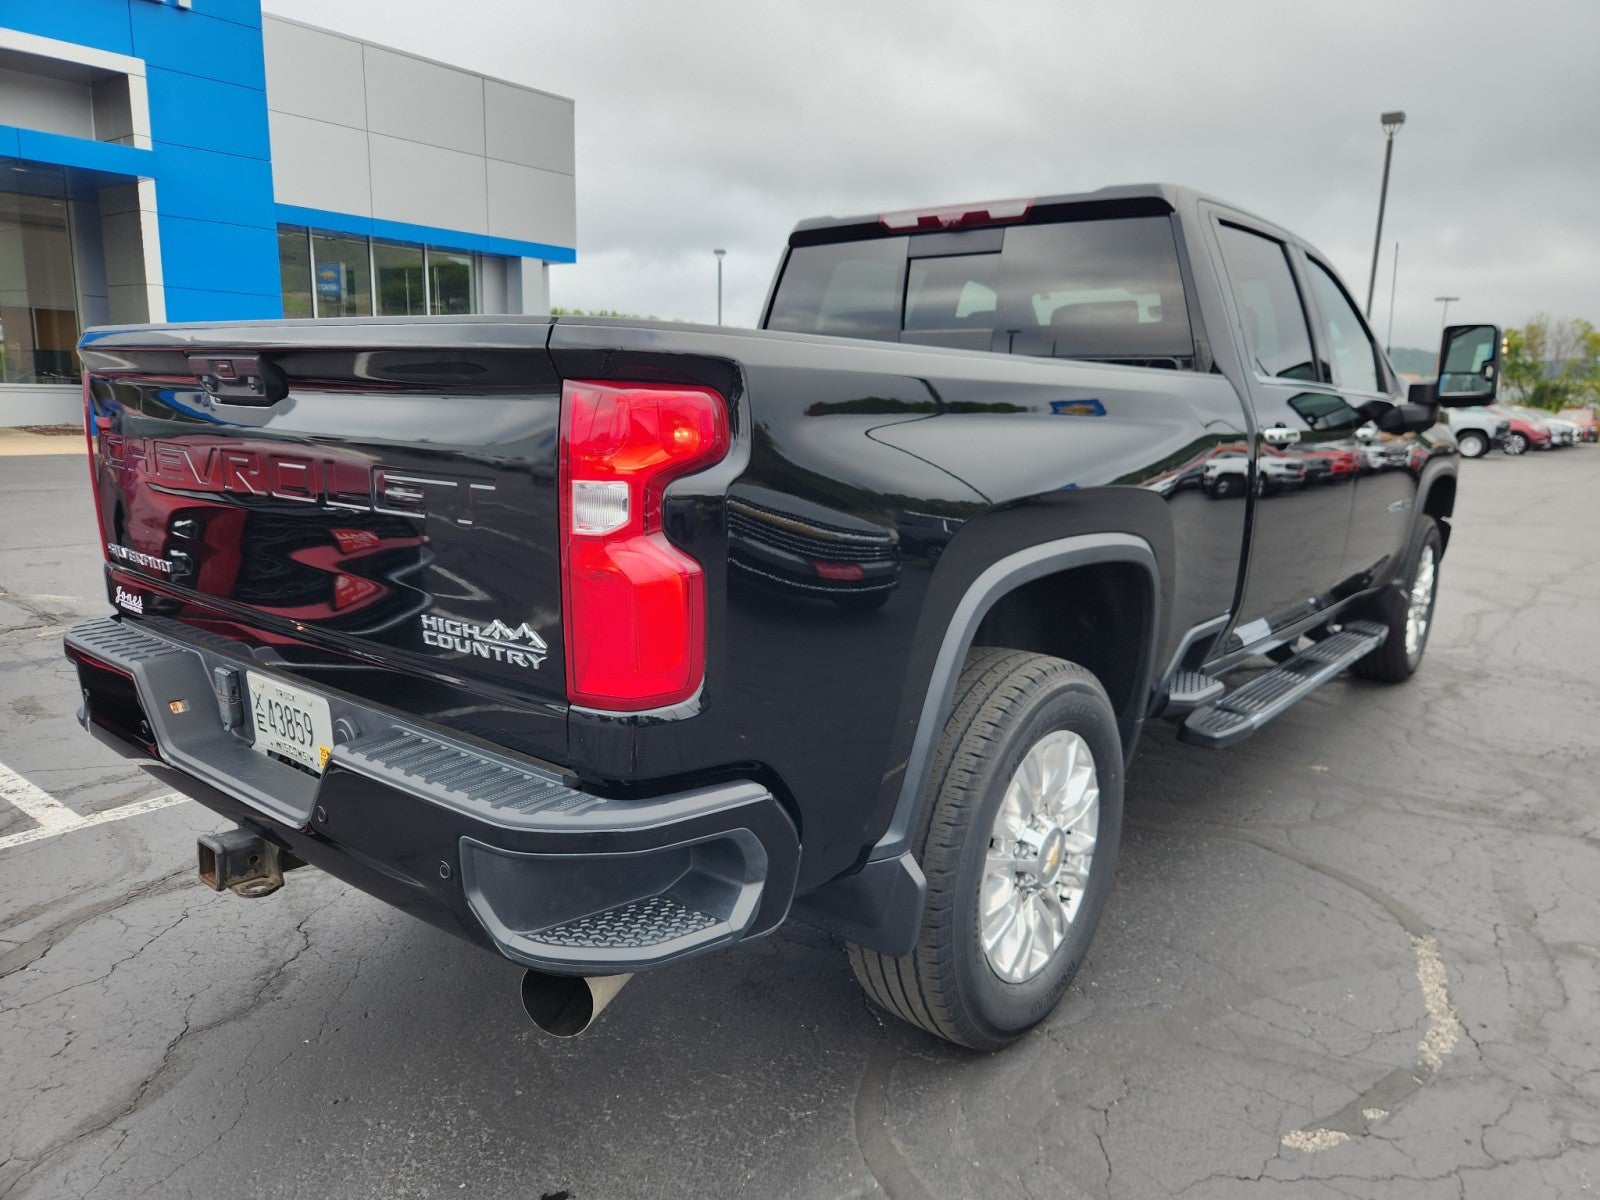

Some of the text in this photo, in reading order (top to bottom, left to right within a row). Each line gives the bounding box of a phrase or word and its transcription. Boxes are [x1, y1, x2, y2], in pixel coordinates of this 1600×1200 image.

[99, 430, 496, 525] CHEVROLET
[115, 586, 143, 607] Jones
[421, 614, 480, 640] HIGH
[422, 630, 547, 669] COUNTRY
[268, 698, 314, 748] 43859
